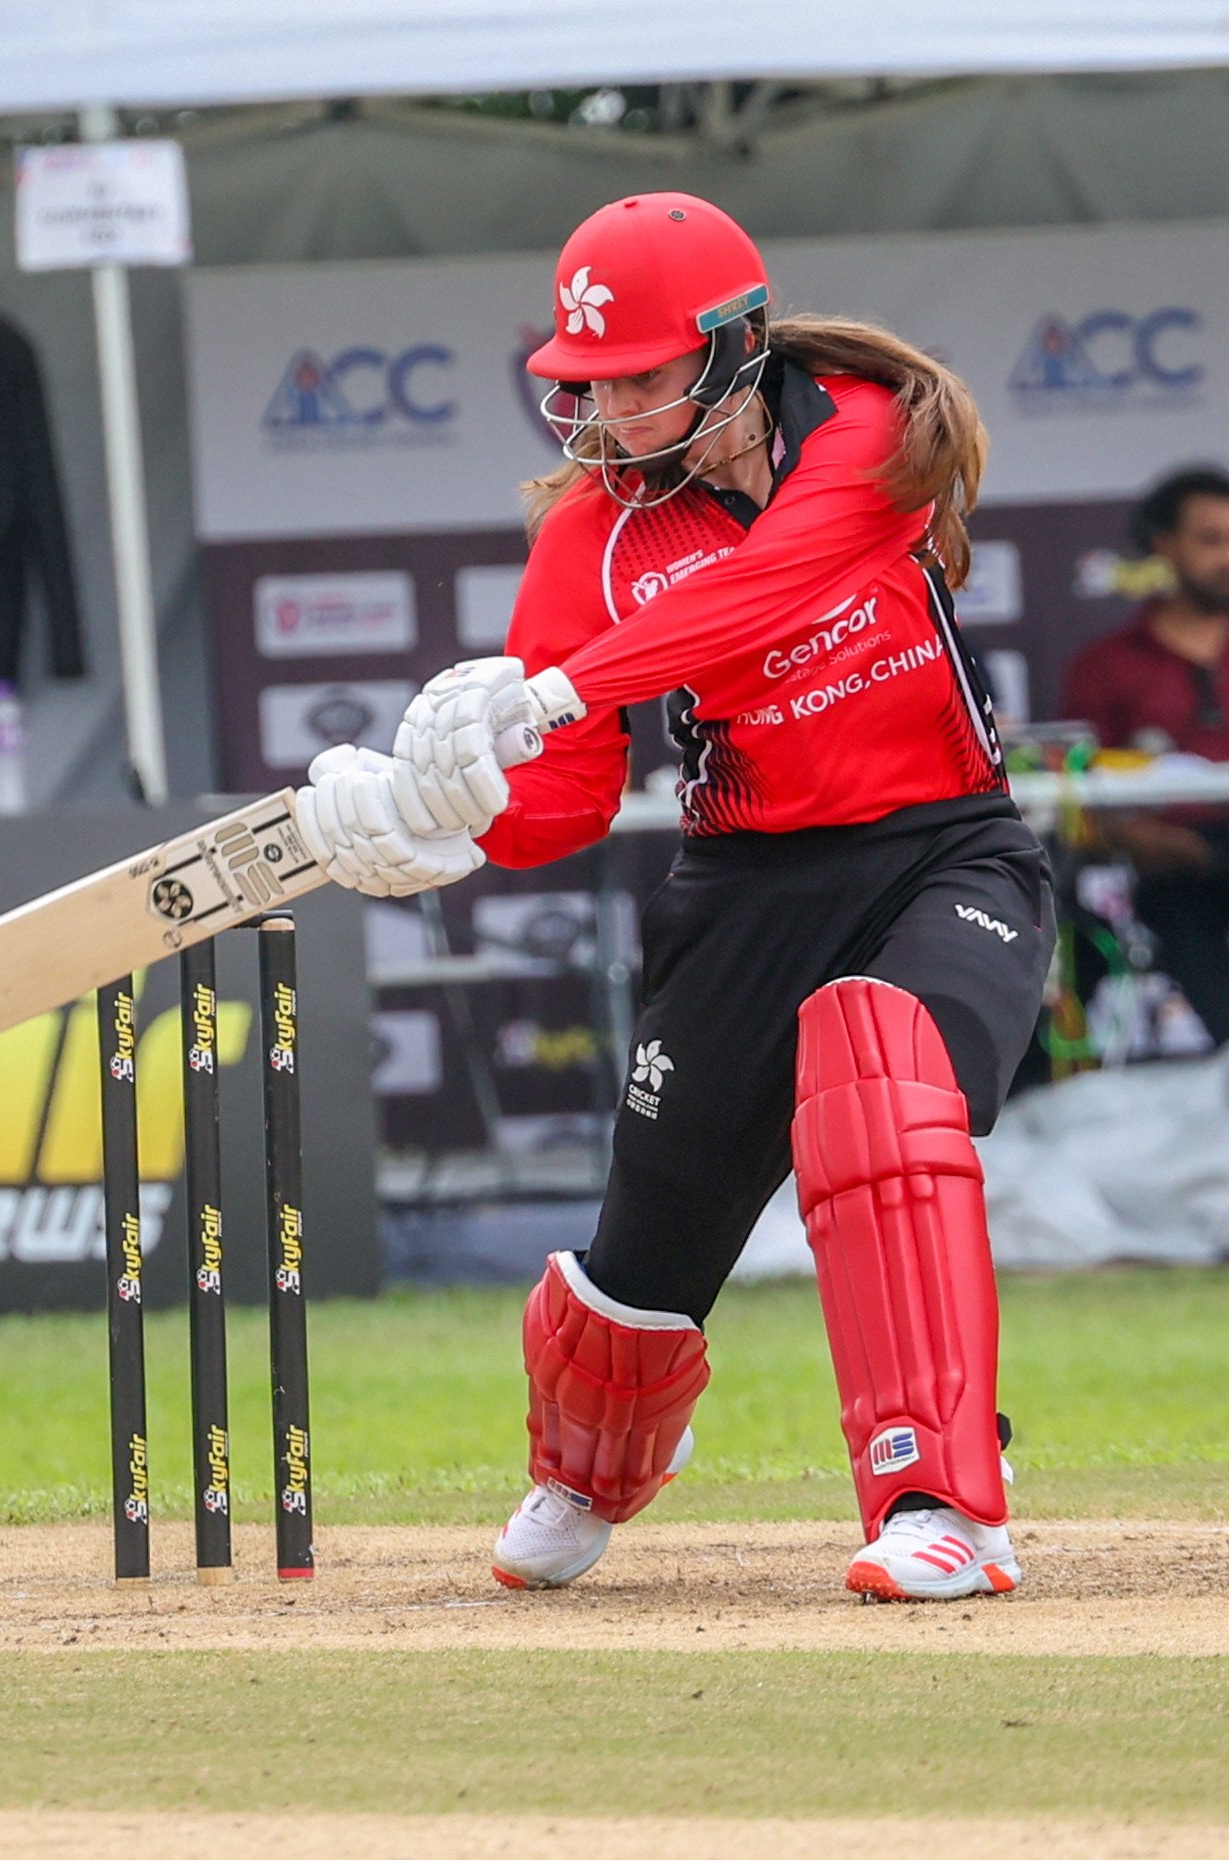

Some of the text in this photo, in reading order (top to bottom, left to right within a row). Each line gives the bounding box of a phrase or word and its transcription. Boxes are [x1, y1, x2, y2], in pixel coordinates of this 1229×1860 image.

[259, 343, 458, 426] ACC
[1004, 306, 1206, 392] ACC
[763, 597, 878, 679] Gencor
